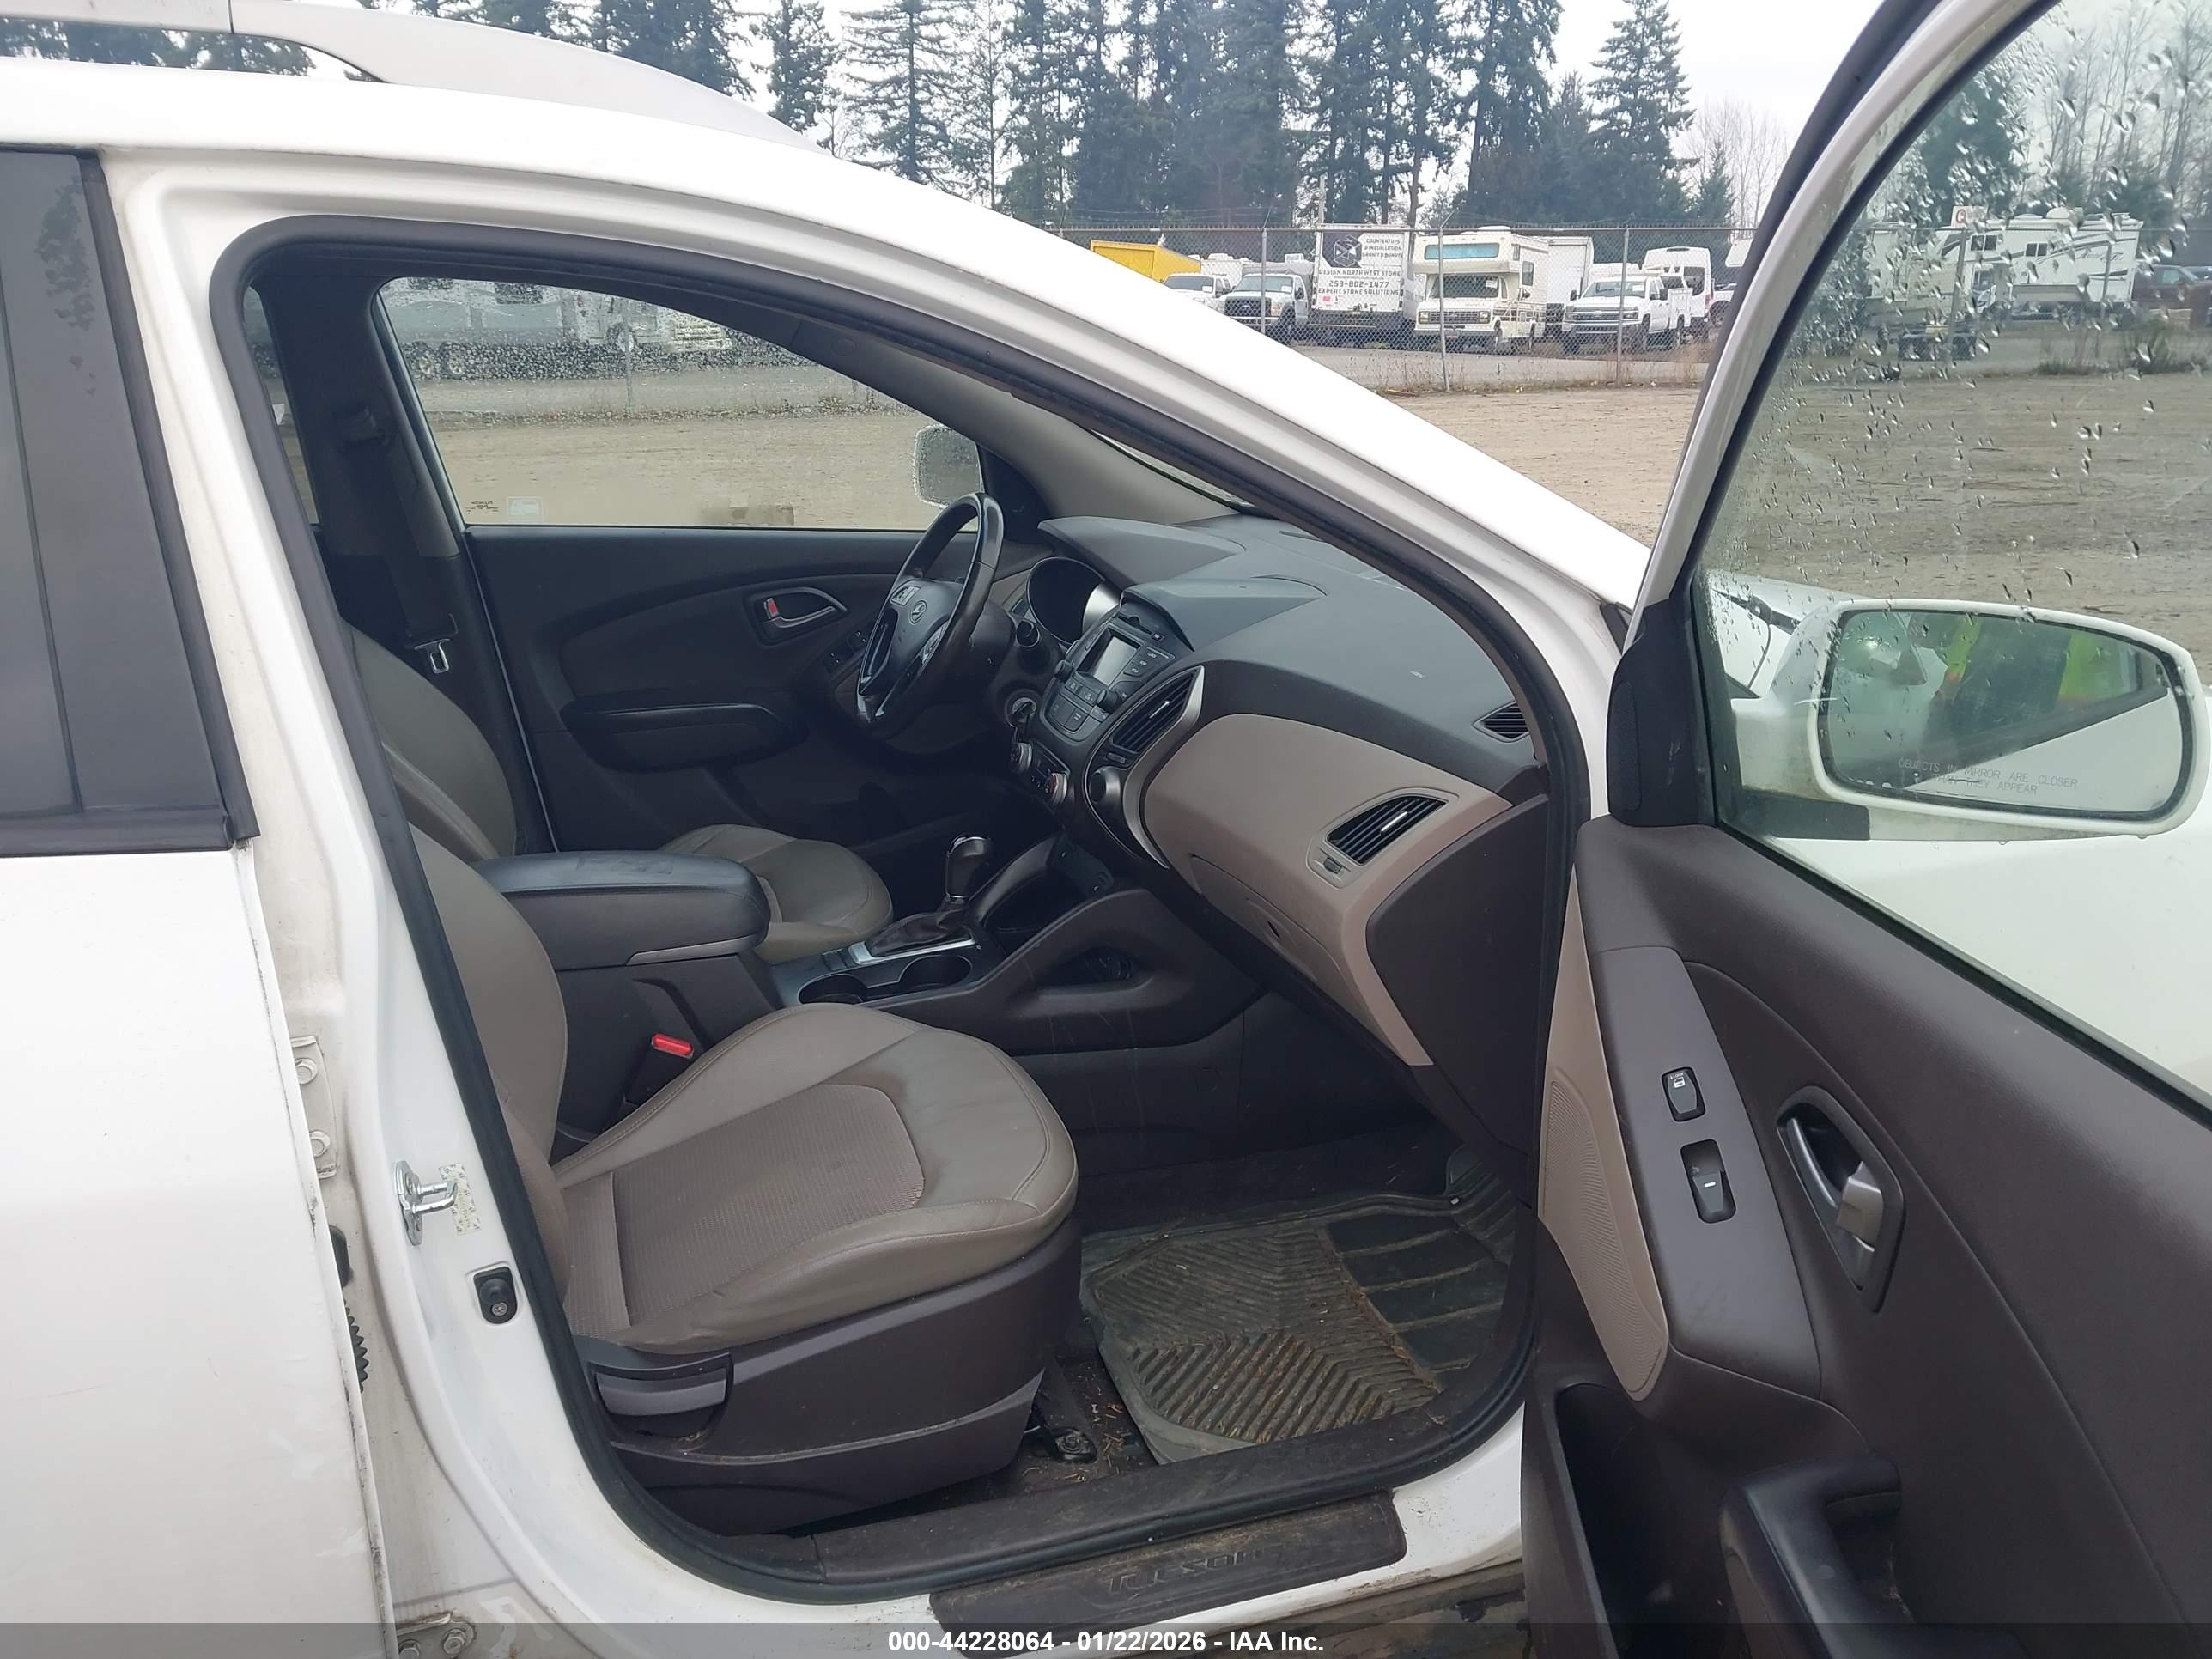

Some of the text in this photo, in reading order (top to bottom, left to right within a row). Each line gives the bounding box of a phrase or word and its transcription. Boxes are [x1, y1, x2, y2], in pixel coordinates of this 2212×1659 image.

[1328, 280, 1389, 289] 253-802-1477
[1898, 757, 1941, 773] OBJECTS
[1964, 767, 2001, 780] MIRROR
[2008, 772, 2028, 783] ARE
[2038, 775, 2079, 787] CLOSER
[1933, 774, 2038, 795] THAN THEY APPEAR
